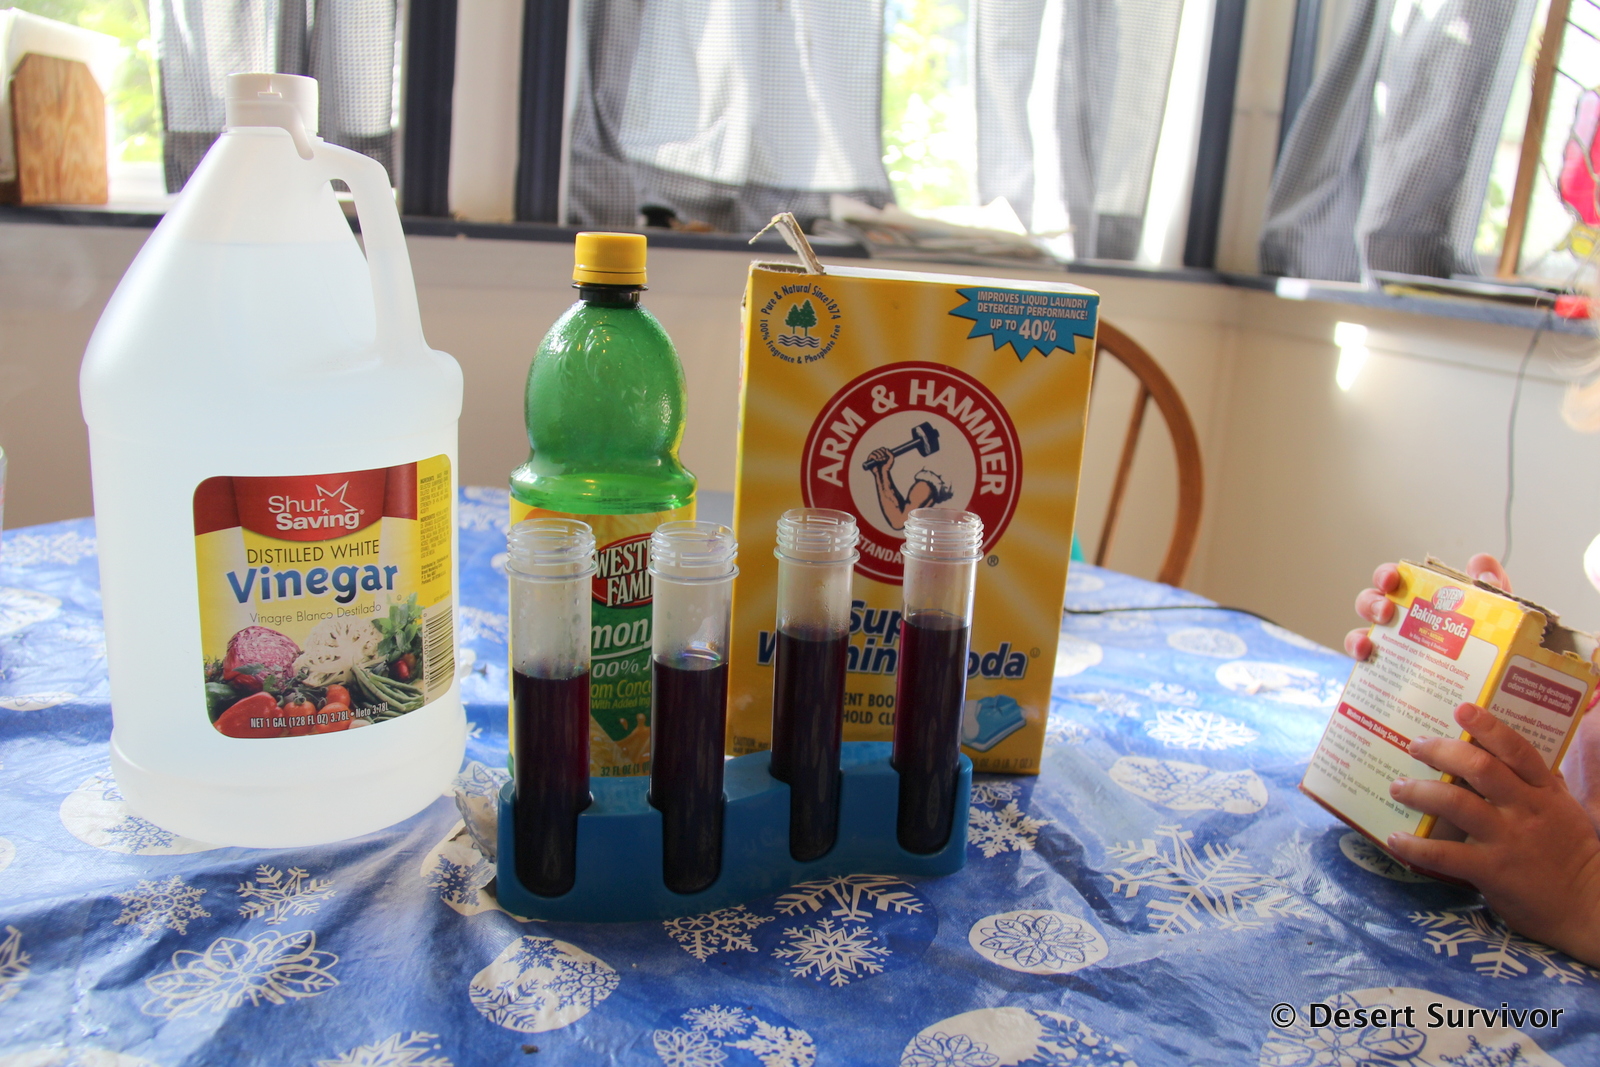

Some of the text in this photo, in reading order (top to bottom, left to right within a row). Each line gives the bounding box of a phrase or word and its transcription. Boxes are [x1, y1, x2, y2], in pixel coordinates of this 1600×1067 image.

[761, 283, 841, 319] Pure & Natural Since 1874
[978, 291, 1088, 308] IMPROVES LIQUID LAUNDRY
[978, 302, 1088, 320] DETERGENT PERFORMANCE!
[760, 319, 840, 364] 100% Fragrance & Phosphate Free
[990, 319, 1057, 342] UP TO 40%
[817, 378, 1007, 496] ARM & HAMMER
[268, 496, 325, 514] Shur
[276, 512, 360, 530] Saving
[248, 540, 380, 564] DISTILLED WHITE
[858, 534, 904, 564] STANDA
[226, 564, 398, 604] Vinegar
[607, 570, 652, 607] FAMI
[250, 602, 382, 626] Vinagre Blanco Destilado
[850, 600, 901, 645] Sup
[1410, 603, 1468, 639] Baking Soda
[591, 618, 648, 649] mon
[592, 659, 638, 678] 00%
[968, 643, 1026, 678] oda
[1381, 632, 1409, 651] Recommended
[1417, 649, 1426, 658] for
[1424, 652, 1449, 670] Household
[1447, 664, 1470, 680] Cleaning
[590, 684, 613, 698] om
[868, 694, 894, 708] BOO
[1507, 680, 1525, 693] odors
[1524, 687, 1543, 701] safely
[1547, 696, 1572, 712] naturally
[1511, 673, 1574, 704] Freshens by destroying
[250, 711, 350, 728] NET 1 GAL (128 FL OZ) 3.78L
[356, 708, 370, 718] Neto
[1358, 716, 1375, 730] Family
[1371, 723, 1388, 738] Baking
[1491, 703, 1500, 711] As
[1504, 707, 1536, 726] Household
[1535, 719, 1565, 737] Deodorizer
